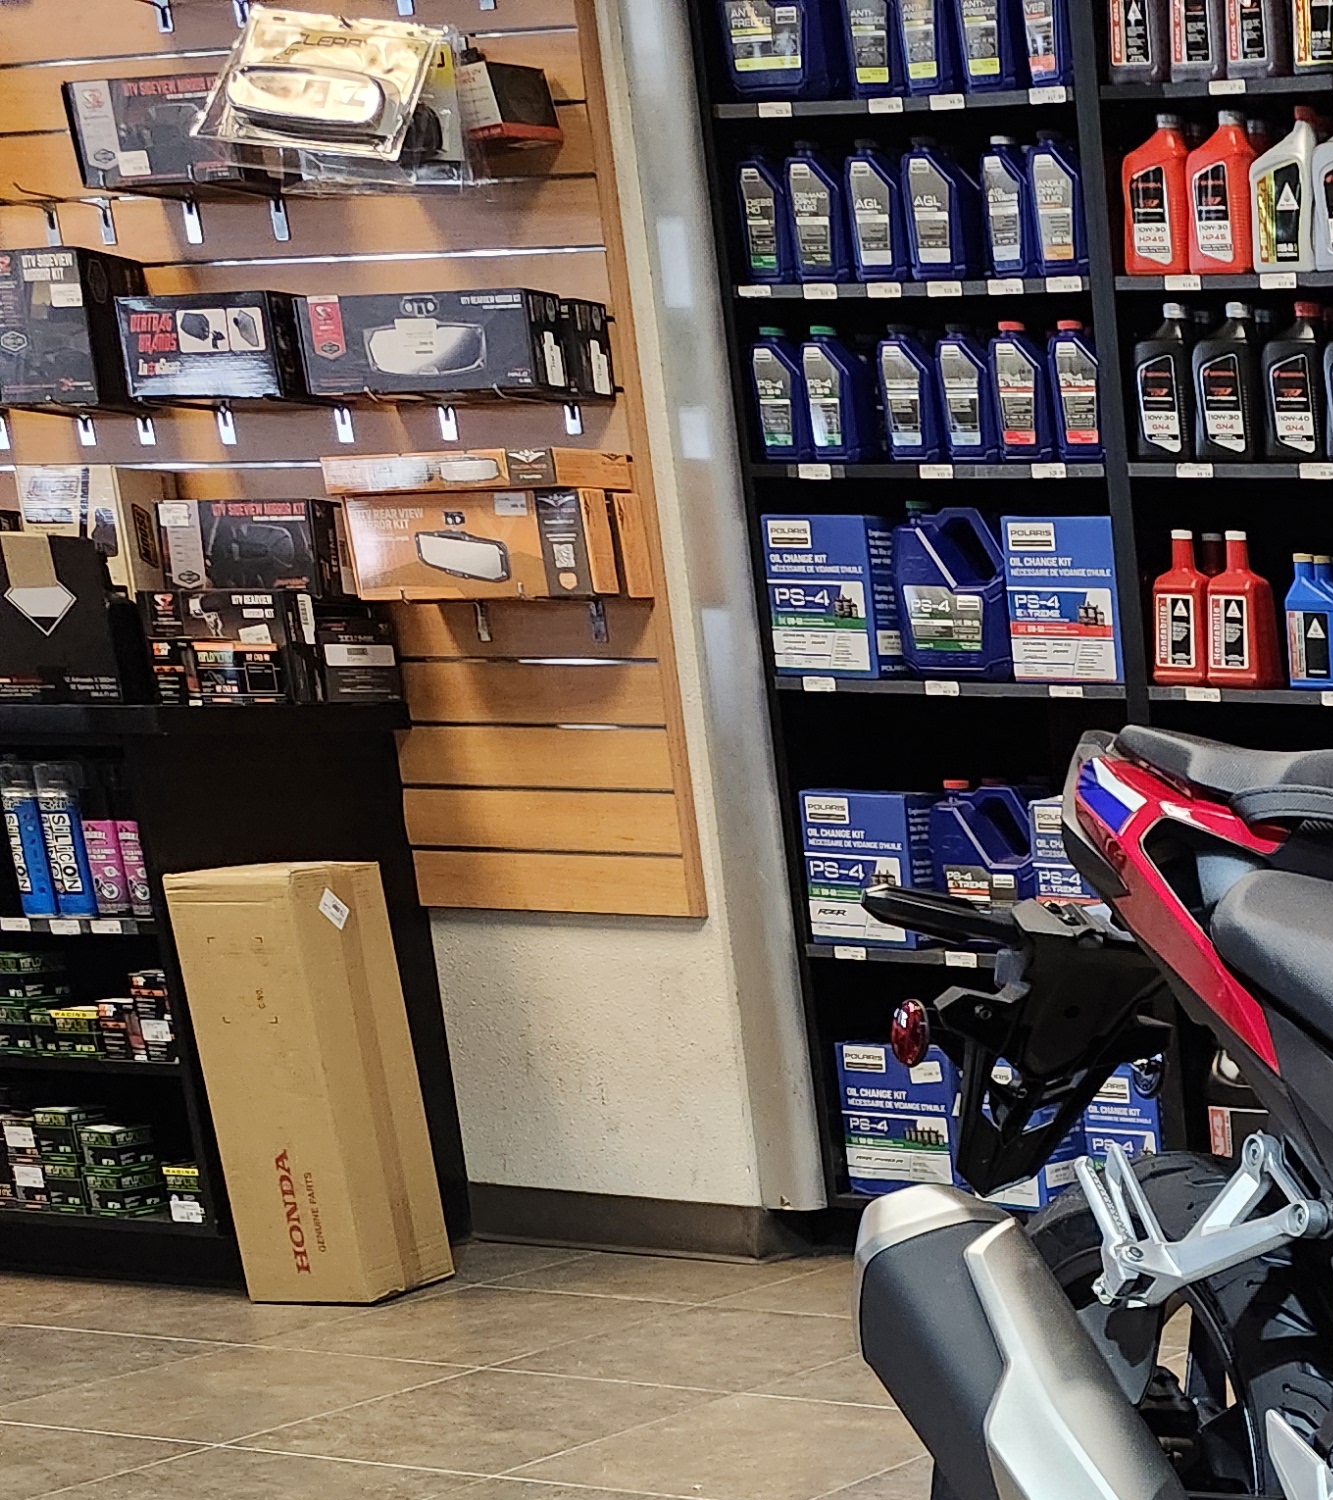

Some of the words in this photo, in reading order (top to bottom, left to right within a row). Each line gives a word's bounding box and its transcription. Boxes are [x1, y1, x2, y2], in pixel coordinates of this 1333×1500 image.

[855, 199, 882, 210] AGL
[913, 195, 941, 207] AGL
[372, 508, 399, 520] REAR
[400, 507, 424, 519] VIEW
[386, 518, 410, 530] KIT
[771, 527, 807, 535] POLARIS
[1010, 529, 1052, 537] POLARIS
[783, 554, 813, 563] CHANGE
[814, 554, 827, 563] KIT
[1009, 557, 1024, 567] OIL
[1025, 557, 1057, 567] CHANGE
[1058, 557, 1072, 567] KIT
[774, 587, 830, 606] PS-4
[1014, 594, 1060, 609] PS-4
[912, 599, 951, 613] PS-4
[808, 803, 846, 811] POLARIS
[820, 829, 850, 839] CHANGE
[851, 830, 864, 839] KIT
[4, 813, 32, 892] SILICON
[51, 813, 83, 892] SILICON
[809, 860, 865, 880] PS-4
[844, 1052, 883, 1062] POLARIS
[861, 1088, 892, 1099] CHANGE
[893, 1089, 907, 1100] KIT
[1101, 1105, 1126, 1116] CHANGE
[1127, 1107, 1141, 1117] KIT
[849, 1117, 888, 1132] PS-4
[304, 1172, 318, 1205] PARTS
[275, 1150, 311, 1274] HONDA
[312, 1207, 326, 1253] GENUINE
